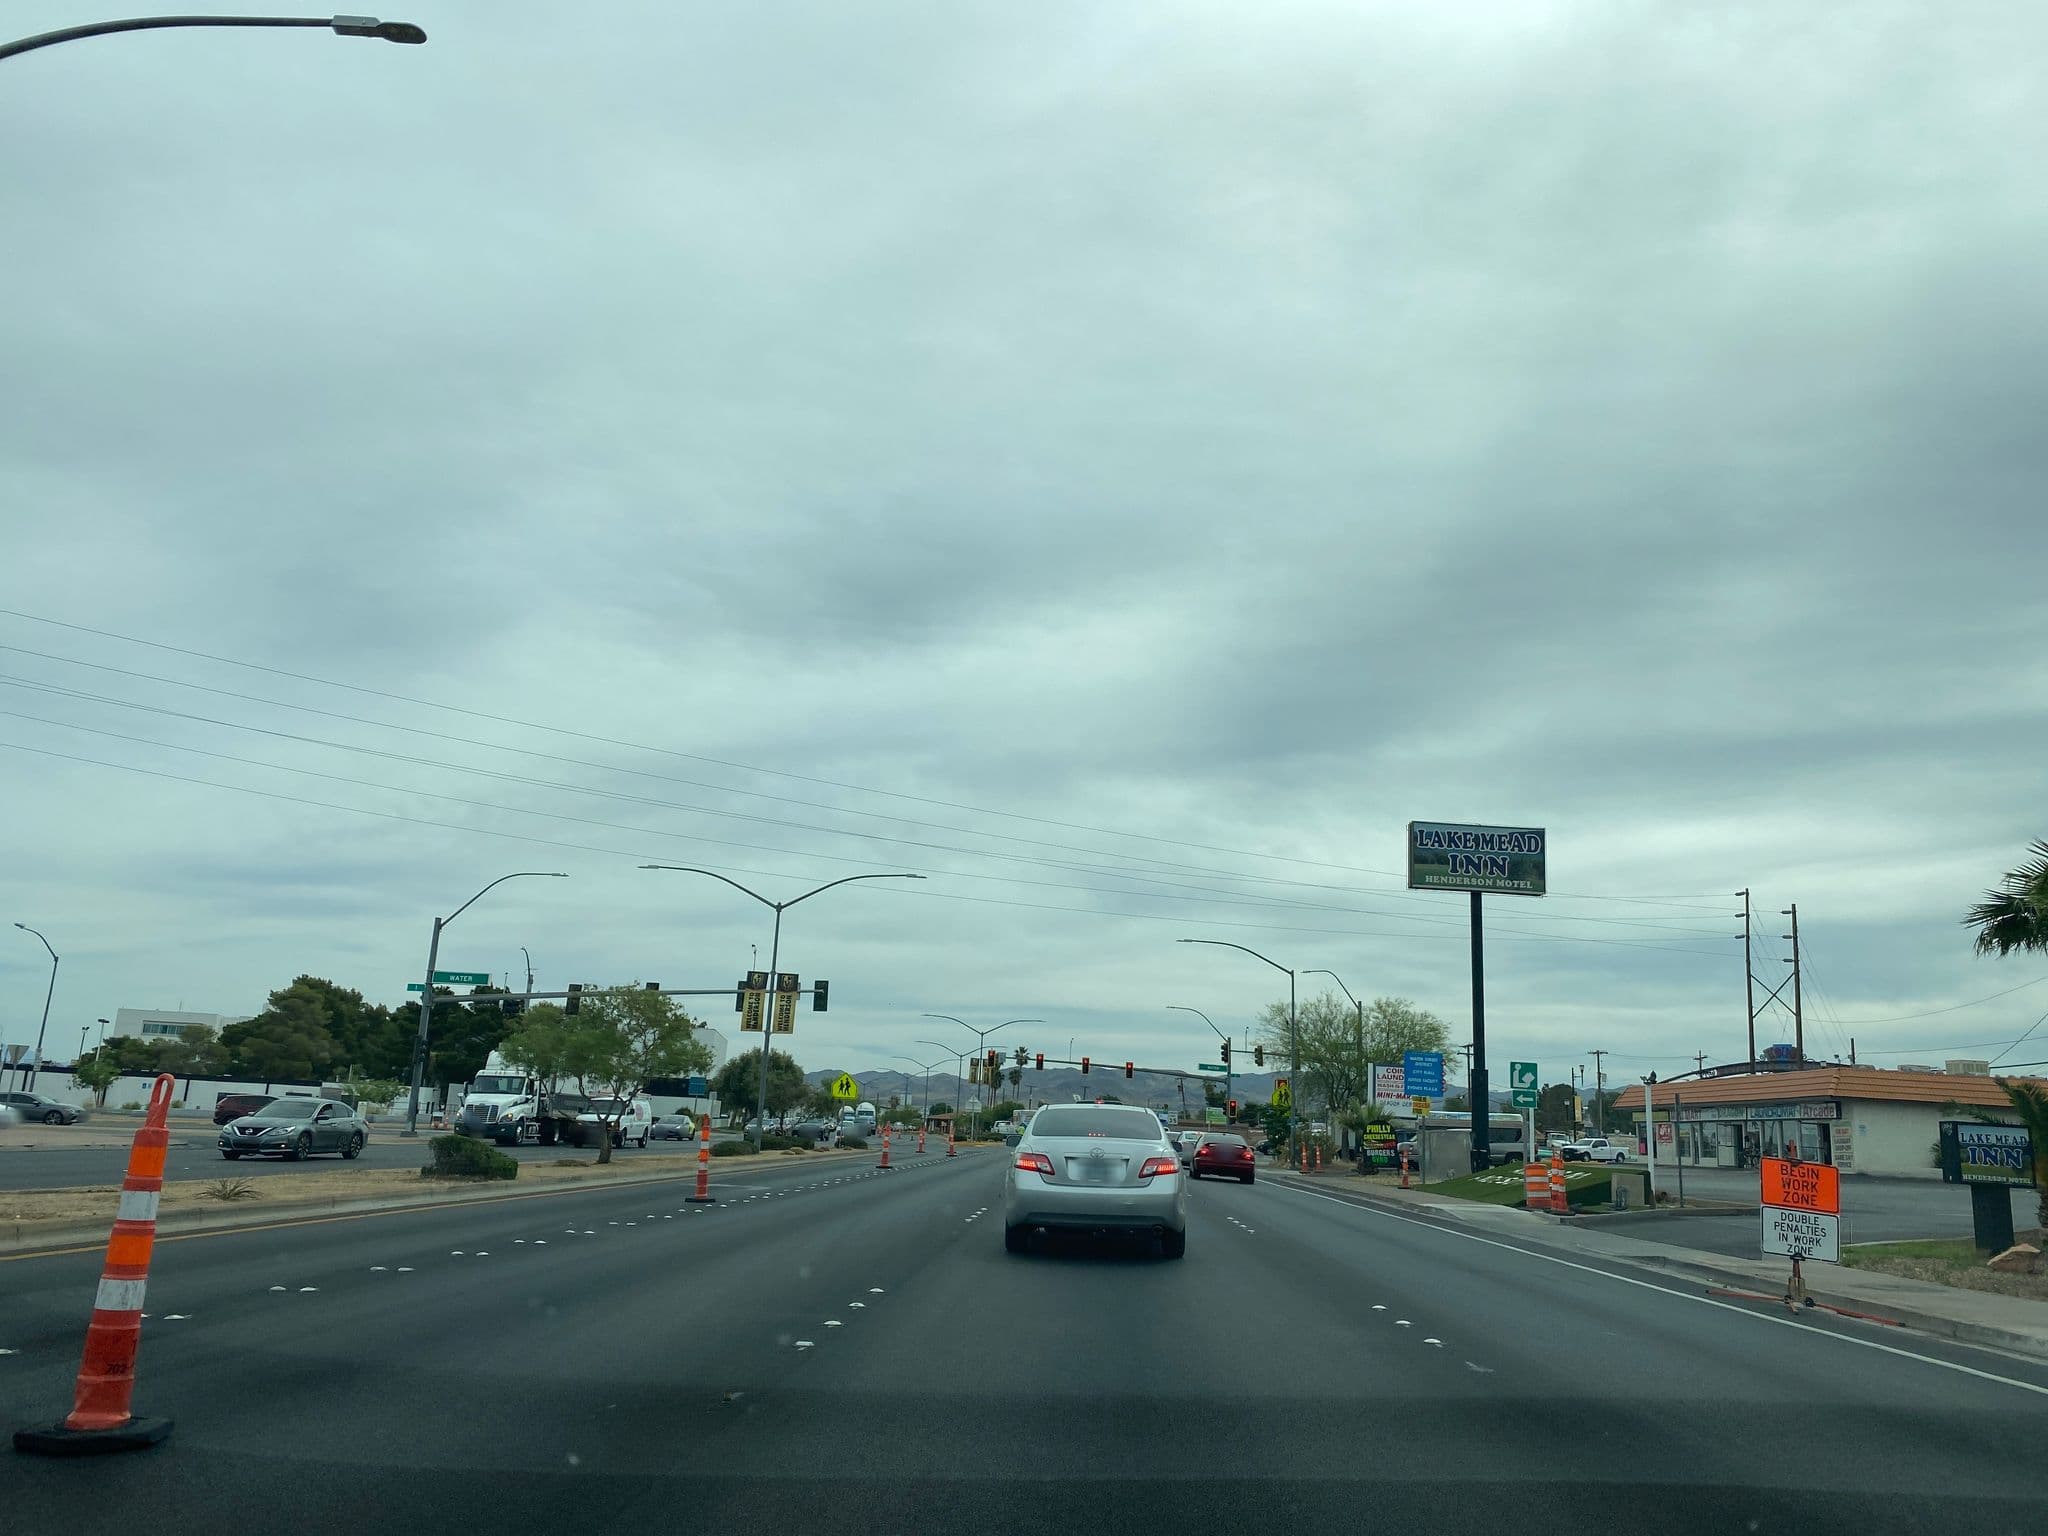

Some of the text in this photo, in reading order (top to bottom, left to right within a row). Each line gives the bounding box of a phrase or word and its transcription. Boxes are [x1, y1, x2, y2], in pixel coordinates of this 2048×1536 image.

[1416, 829, 1542, 854] LAKE MEAD
[1448, 853, 1510, 877] INN
[1425, 875, 1534, 889] HENDERSON MOTEL
[1802, 1103, 1836, 1118] Arcade
[1366, 1124, 1391, 1133] PHILLY
[1960, 1132, 2028, 1147] LAKE MEAD
[1366, 1149, 1395, 1157] BURGERS
[1967, 1145, 2023, 1169] INN
[1780, 1163, 1820, 1180] BEGIN
[1781, 1177, 1818, 1193] WORK
[2008, 1176, 2033, 1184] MOTEL
[1783, 1191, 1818, 1207] ZONE
[1780, 1211, 1820, 1226] DOUBLE
[1774, 1221, 1827, 1238] PENALTIES
[1778, 1232, 1822, 1247] IN WORK
[1787, 1244, 1814, 1256] ZONE
